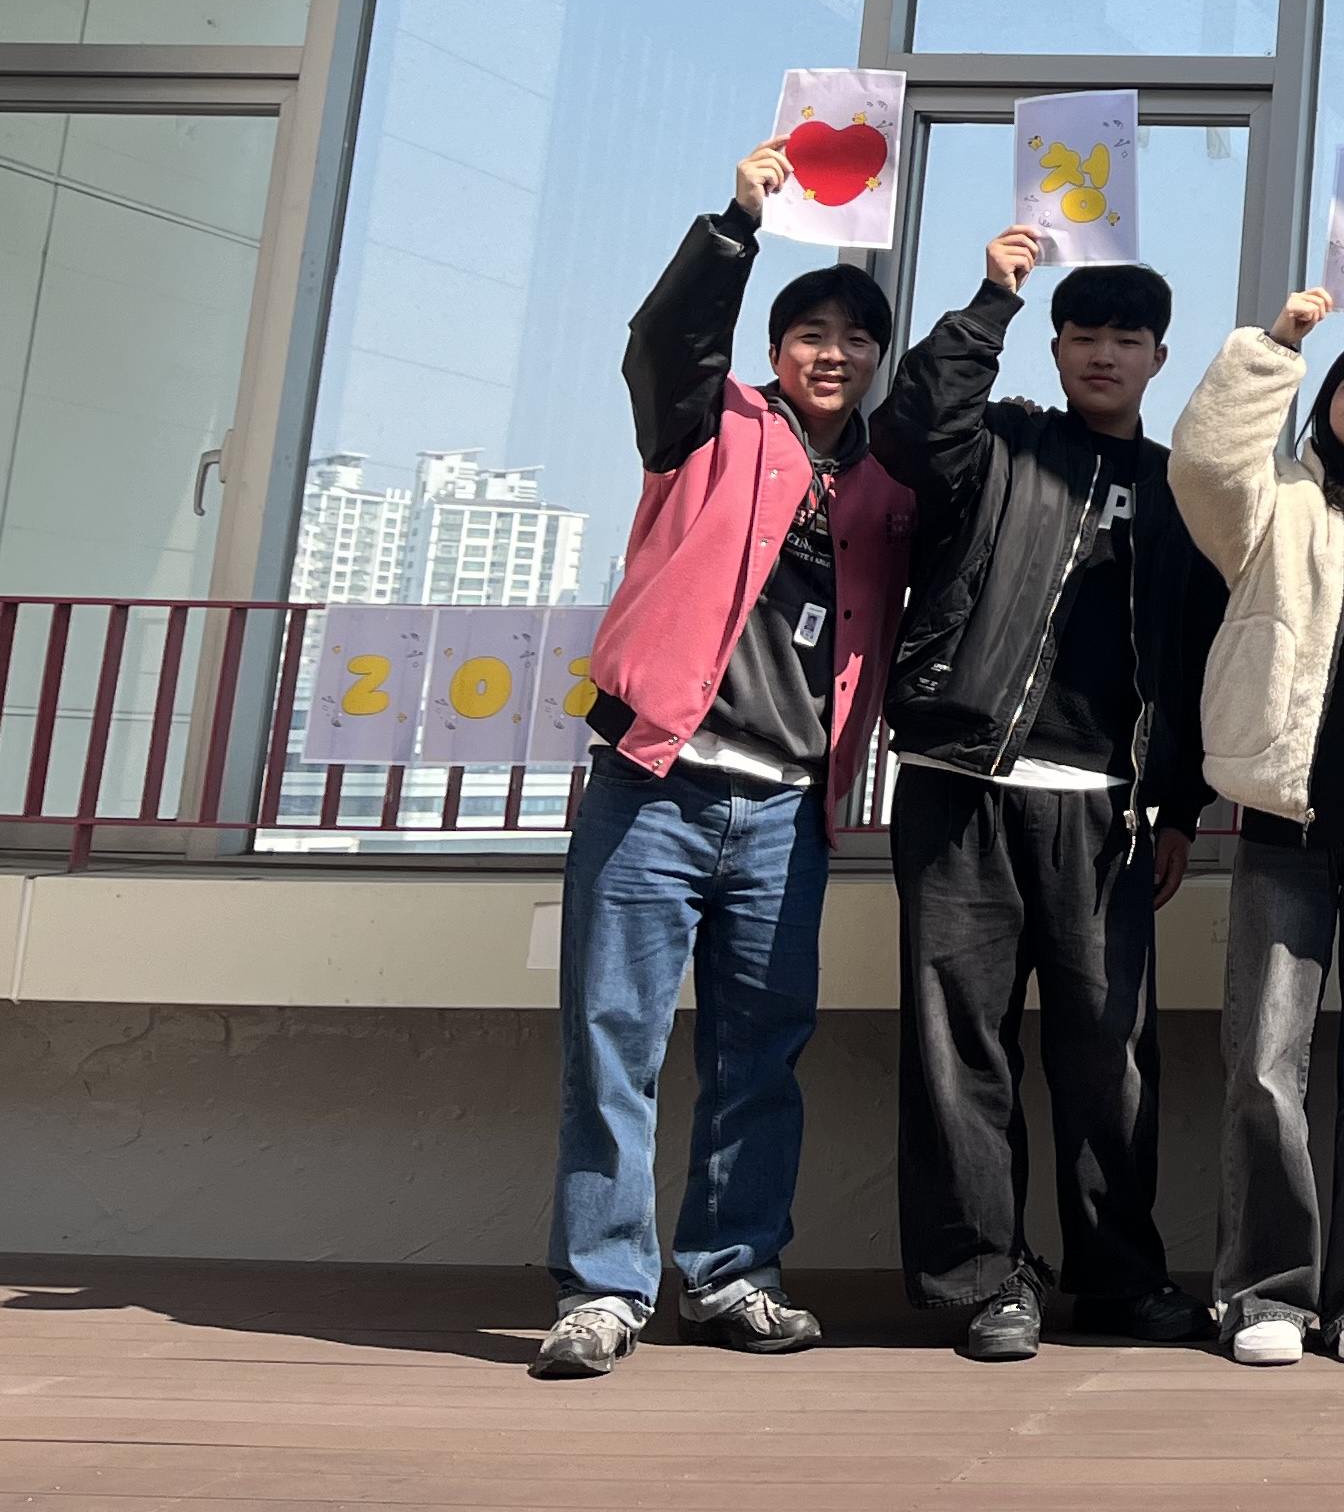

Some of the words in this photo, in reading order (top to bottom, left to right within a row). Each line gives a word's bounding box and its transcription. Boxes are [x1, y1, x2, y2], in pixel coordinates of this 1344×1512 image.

[1039, 142, 1110, 224] 청
[341, 654, 391, 716] 2
[449, 656, 512, 719] 0
